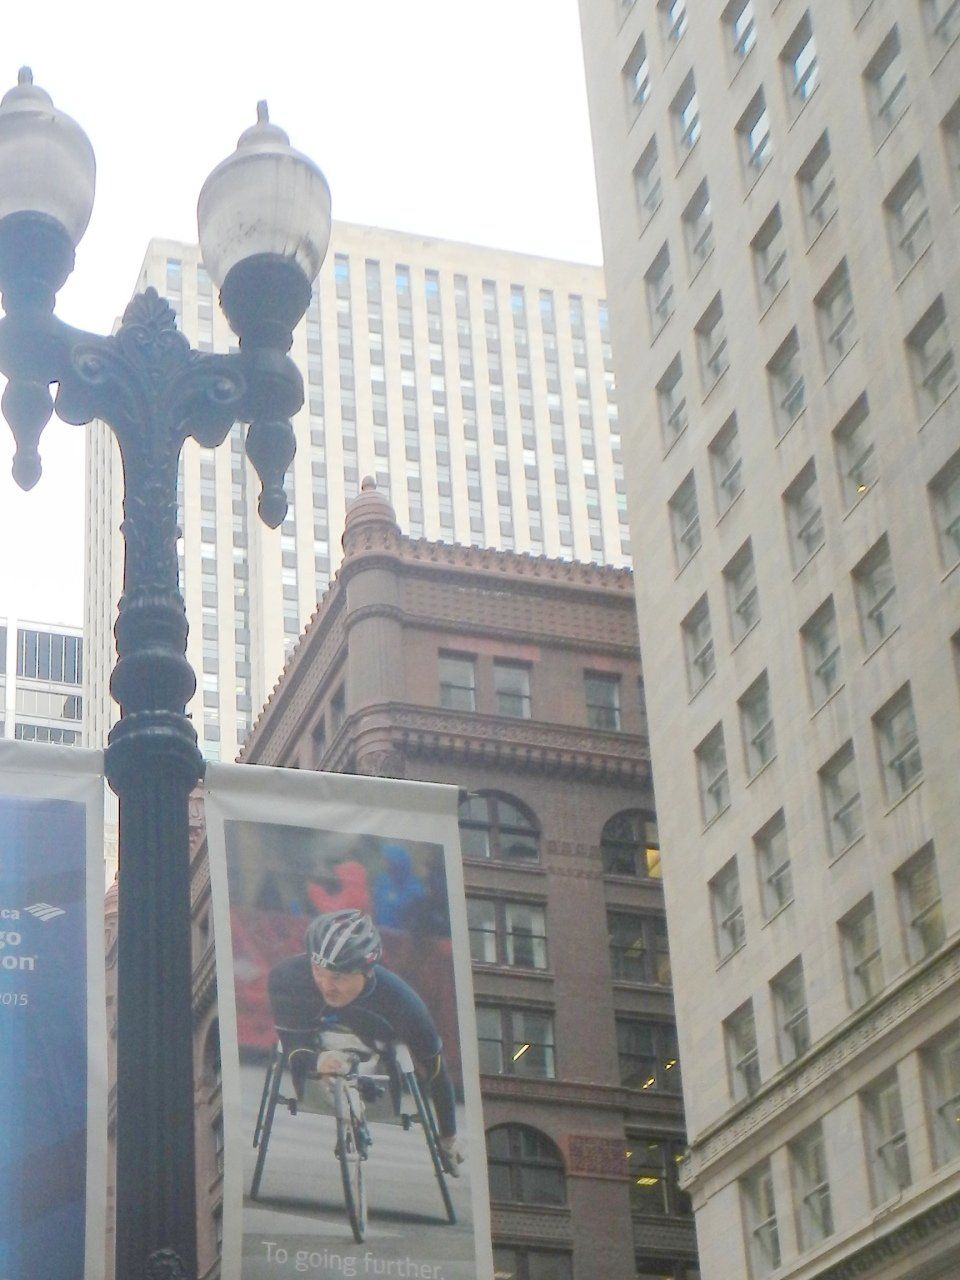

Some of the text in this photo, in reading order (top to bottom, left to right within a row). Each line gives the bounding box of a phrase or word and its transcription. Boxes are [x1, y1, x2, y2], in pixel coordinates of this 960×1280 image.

[261, 1241, 445, 1280] To going further.
